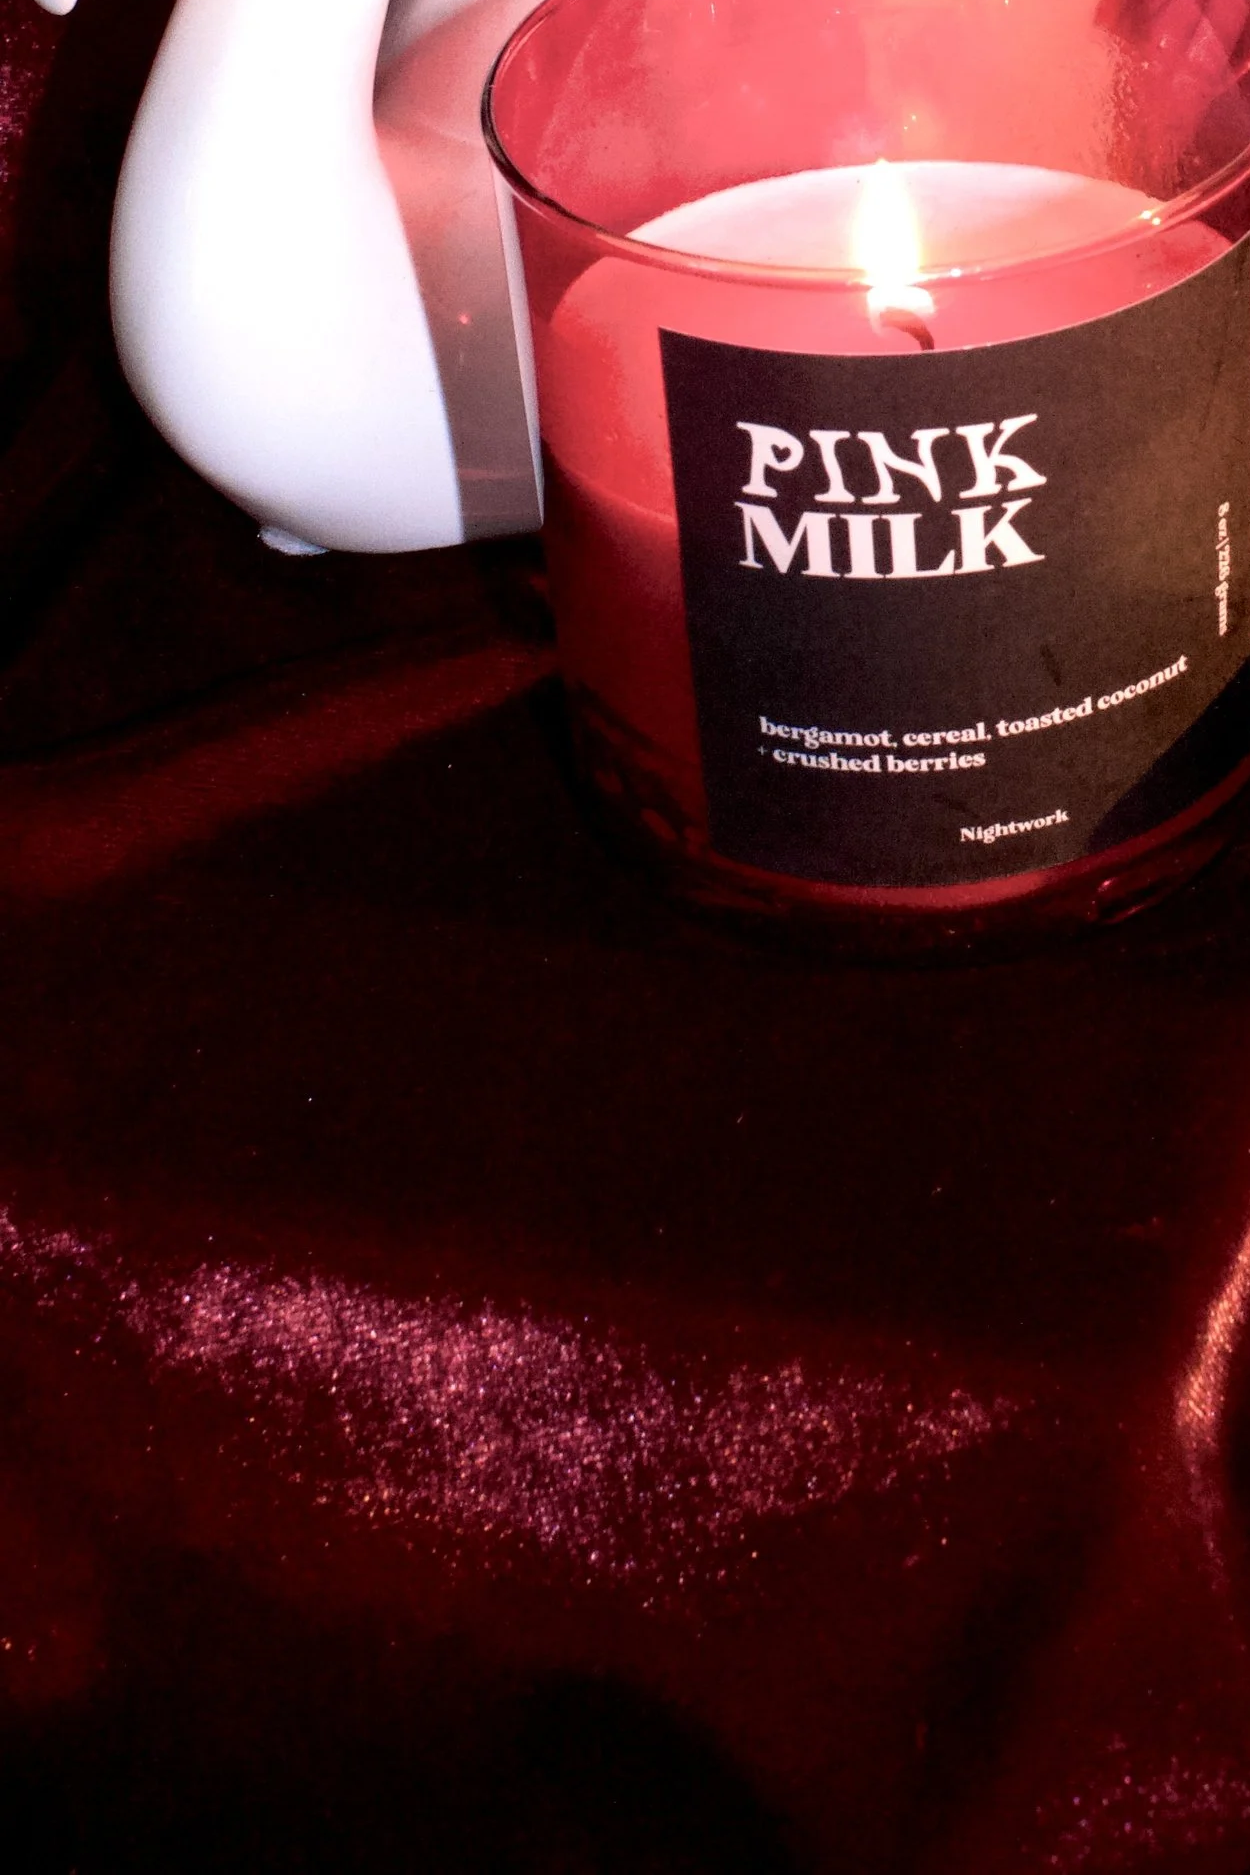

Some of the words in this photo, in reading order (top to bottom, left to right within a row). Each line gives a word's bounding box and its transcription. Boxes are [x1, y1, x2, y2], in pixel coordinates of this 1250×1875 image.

[736, 413, 1047, 503] PINK
[1218, 502, 1230, 517] 8
[734, 497, 1046, 579] MILK
[1214, 581, 1229, 636] grams
[759, 716, 899, 749] bergamot,
[902, 722, 992, 746] cereal,
[995, 696, 1093, 737] toasted
[1097, 654, 1188, 710] coconut
[758, 745, 767, 756] +
[772, 748, 882, 773] crushed
[886, 751, 987, 773] berries
[960, 809, 1069, 843] Nightwork
